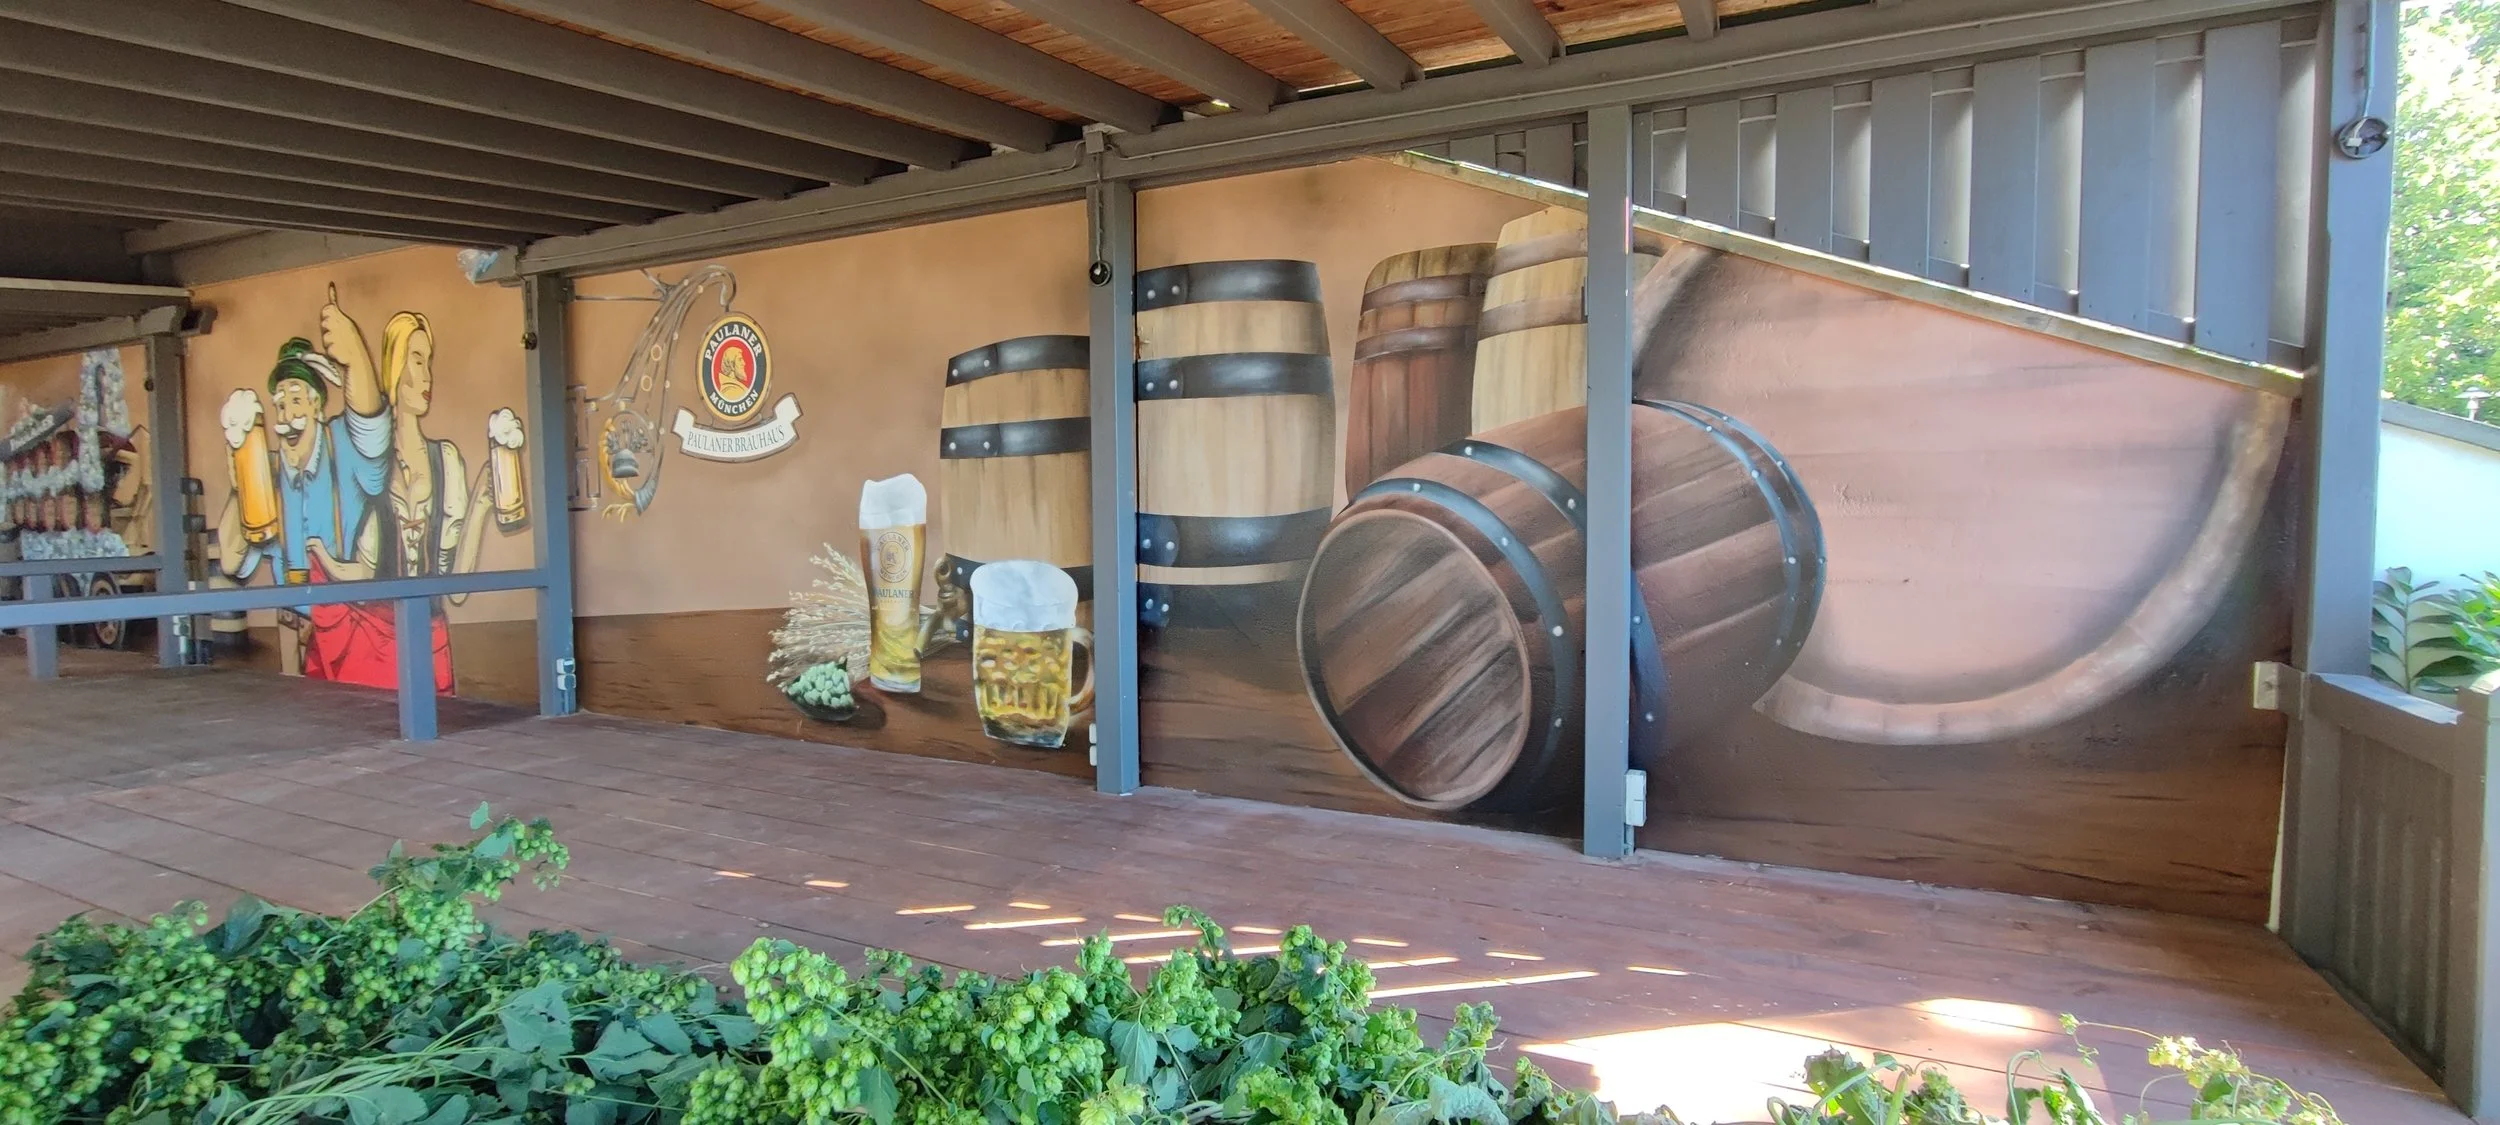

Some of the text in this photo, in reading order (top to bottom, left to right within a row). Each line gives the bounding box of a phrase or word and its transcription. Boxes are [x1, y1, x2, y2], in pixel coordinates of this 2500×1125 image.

[704, 324, 762, 361] PAULANER
[709, 389, 759, 415] MÜNCHEN
[687, 431, 734, 453] PAULANER
